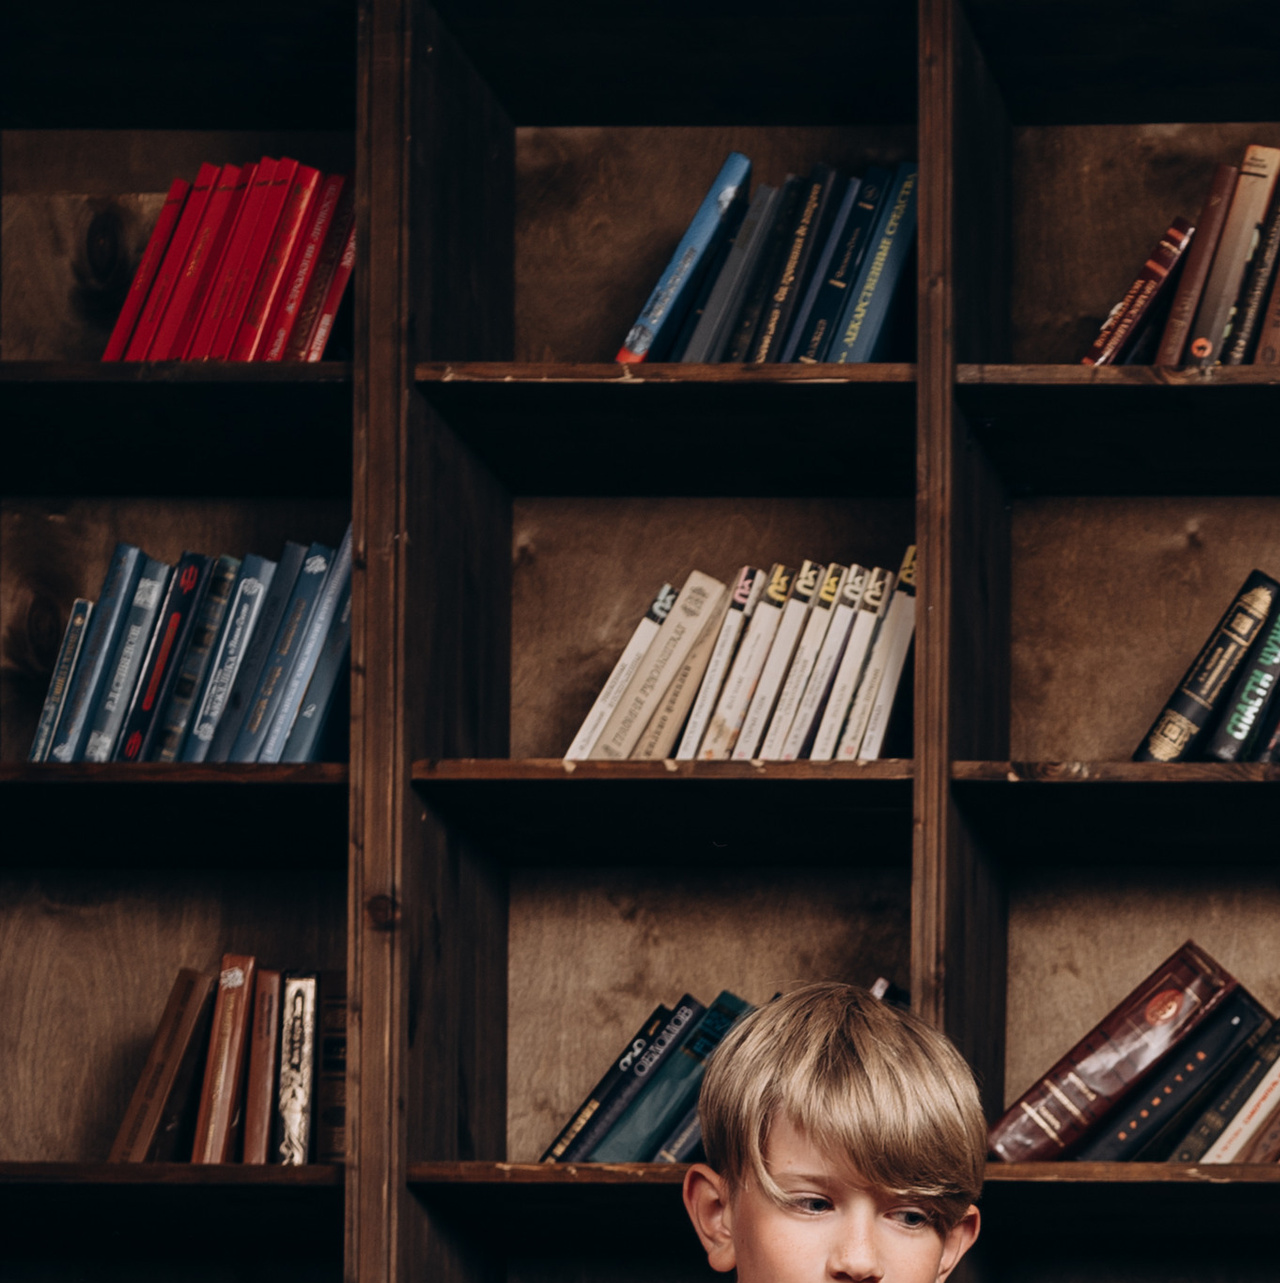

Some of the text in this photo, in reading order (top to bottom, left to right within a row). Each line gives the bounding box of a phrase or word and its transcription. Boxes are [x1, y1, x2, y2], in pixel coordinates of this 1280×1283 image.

[841, 235, 894, 347] ЛЕКАРСТВЕННЫЕ
[883, 170, 918, 236] СРЕДСТВА
[1222, 666, 1276, 742] СПАСТИ
[631, 1002, 695, 1079] ОБЛОМОВ
